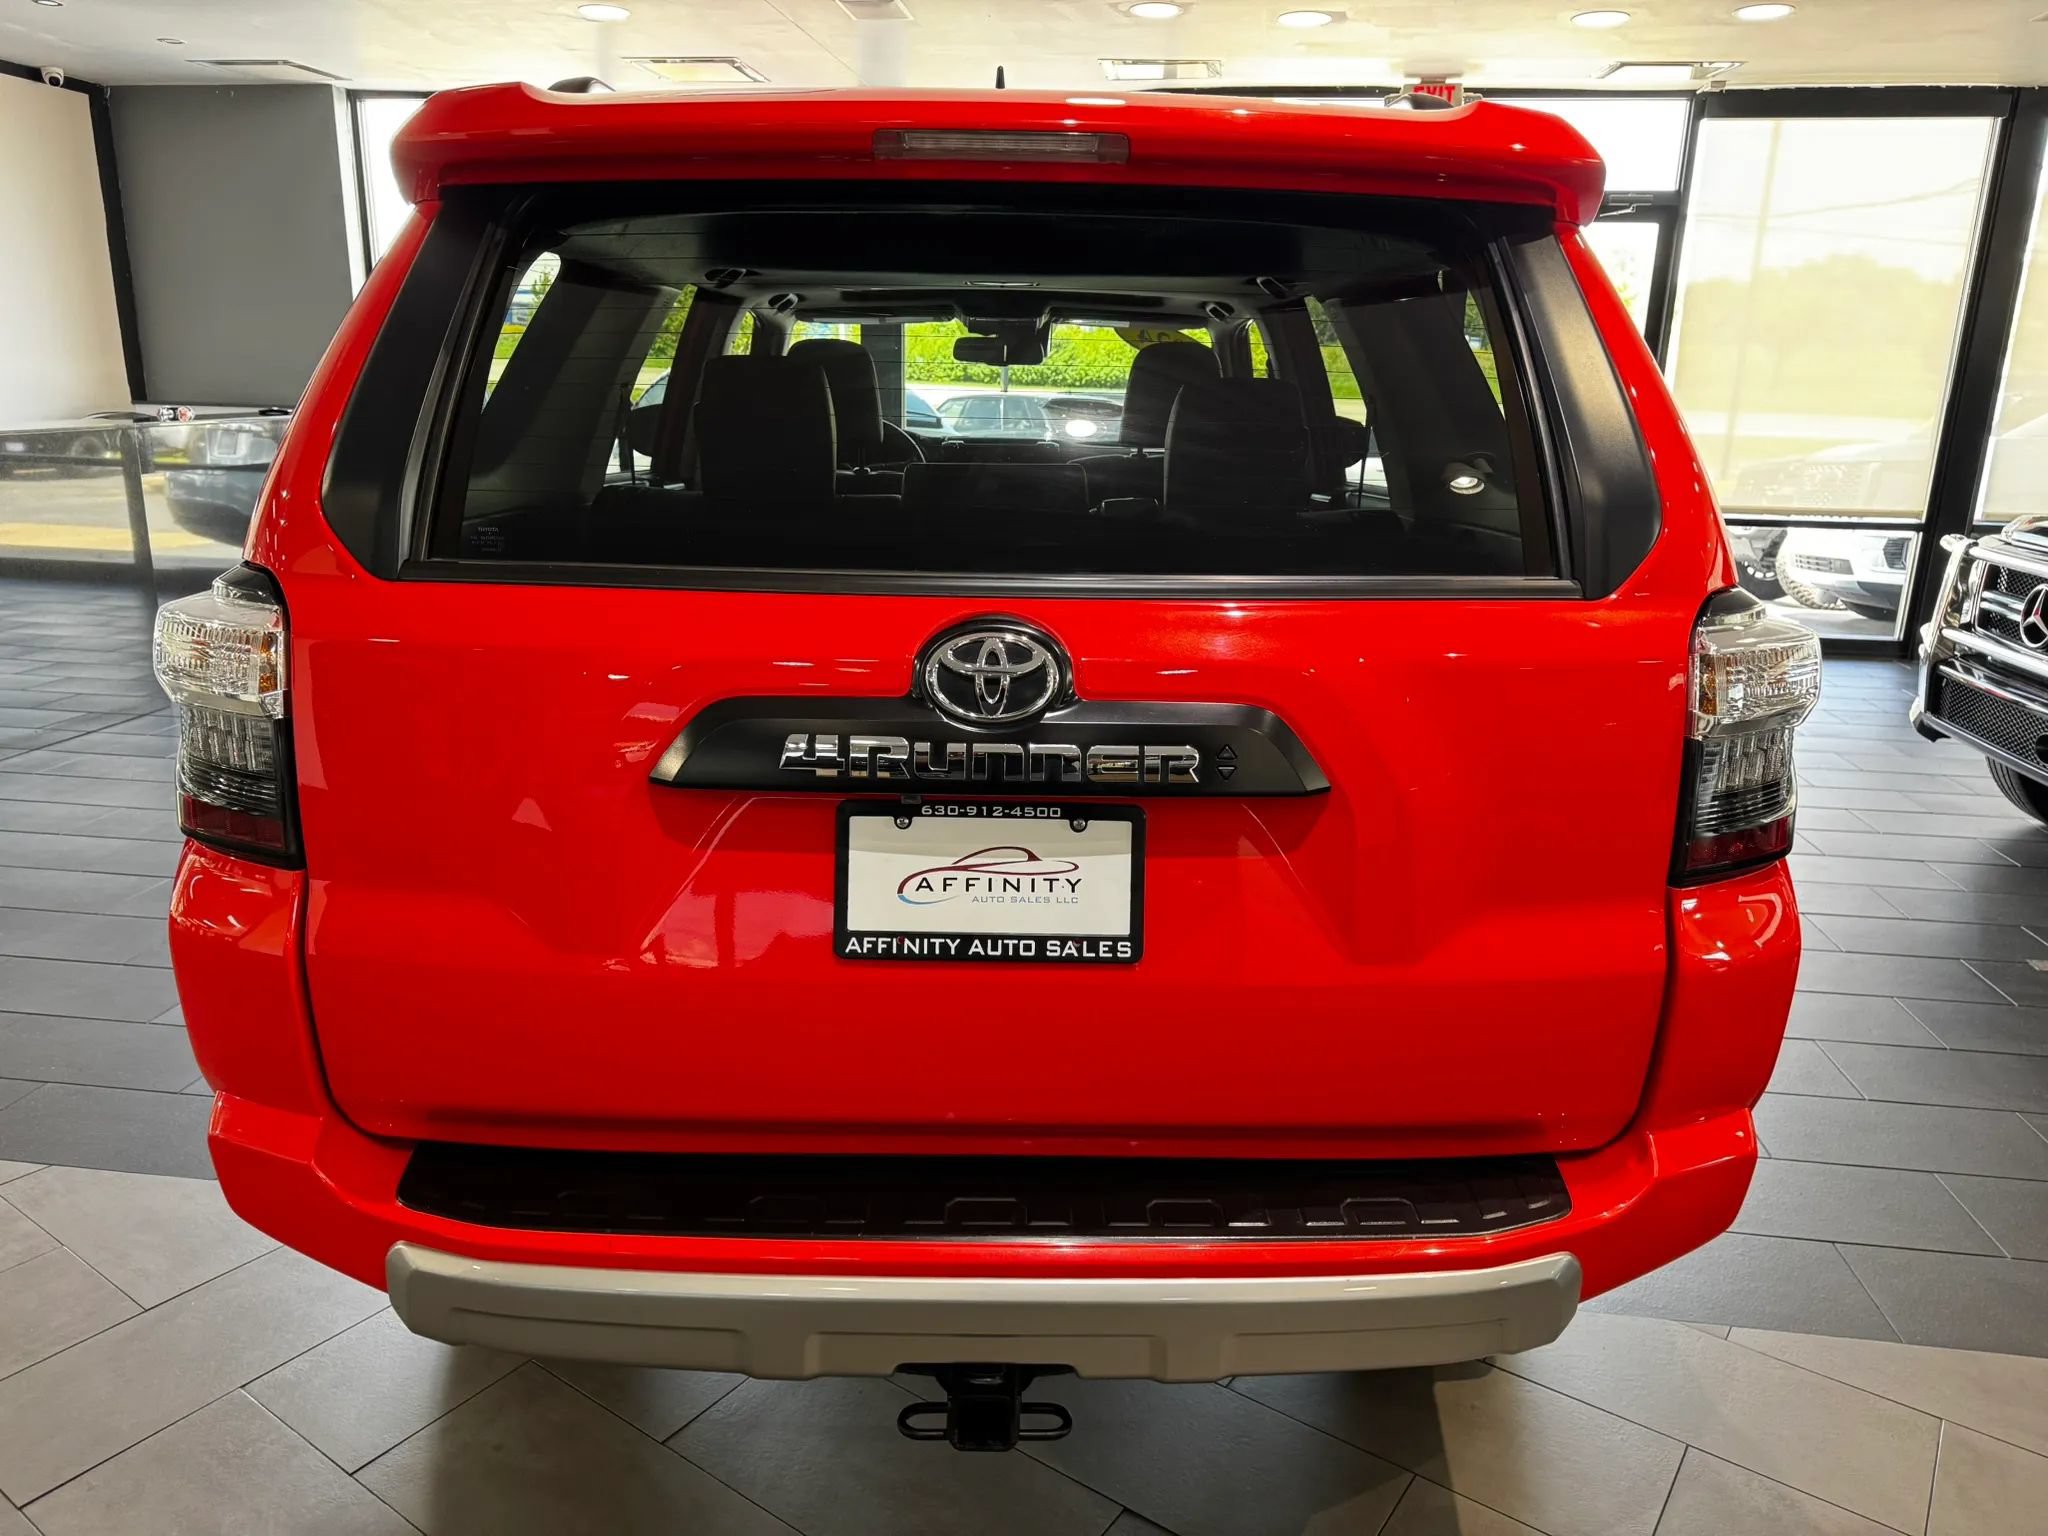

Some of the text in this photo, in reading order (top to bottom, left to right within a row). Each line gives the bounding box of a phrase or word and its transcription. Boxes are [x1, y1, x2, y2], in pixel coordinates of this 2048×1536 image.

[921, 804, 1061, 818] 630-912-4500
[915, 876, 1083, 894] AFFINITY
[971, 895, 1079, 904] AUTO SALES LLC
[845, 937, 1131, 958] AFFINITY AUTO SALES
